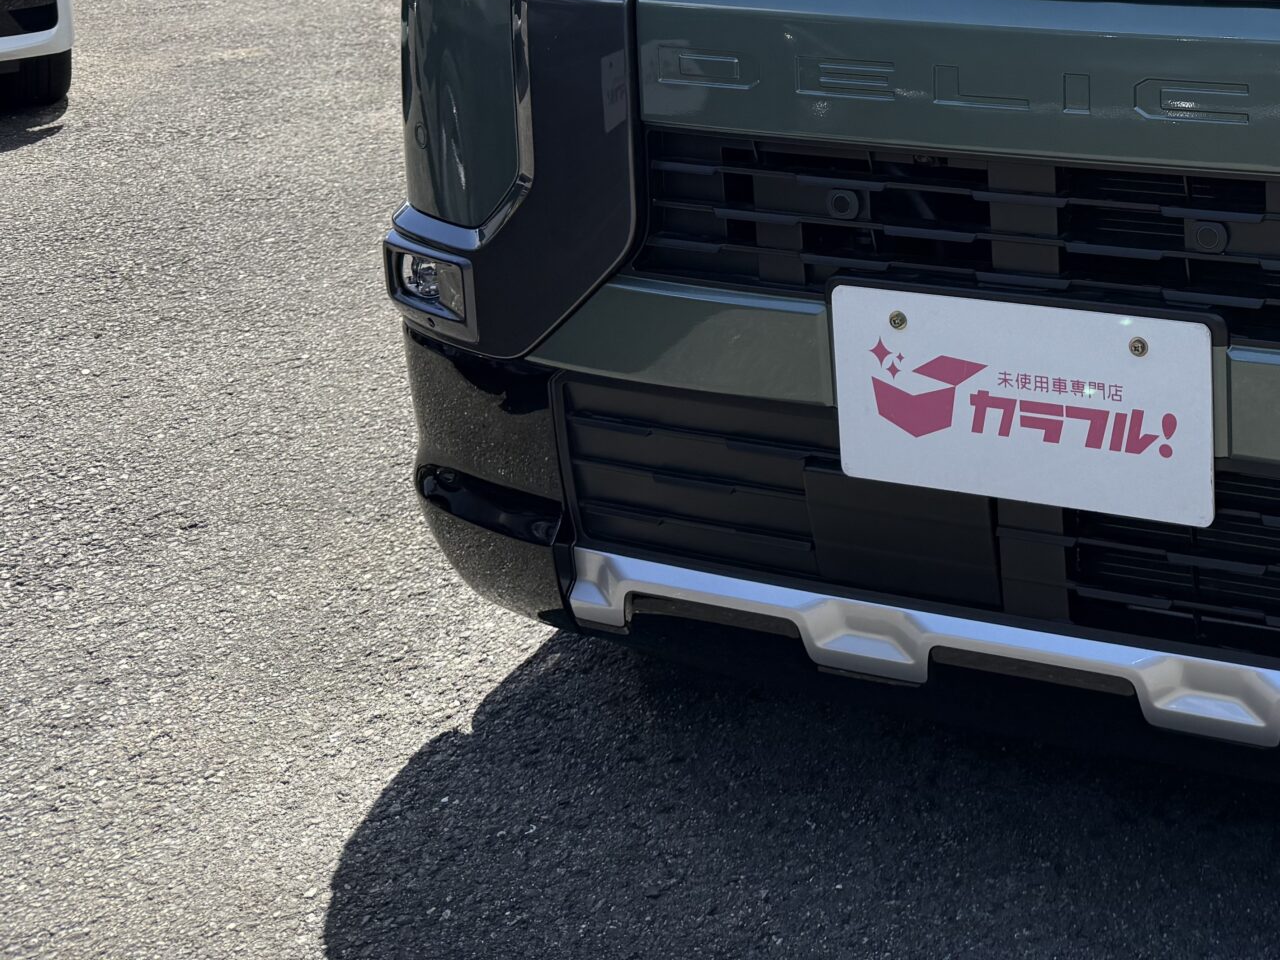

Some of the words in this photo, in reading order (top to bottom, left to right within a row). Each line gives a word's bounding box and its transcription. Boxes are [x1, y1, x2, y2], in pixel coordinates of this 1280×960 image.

[997, 370, 1124, 402] 未使用車専門店
[969, 389, 1178, 459] カラフル!
